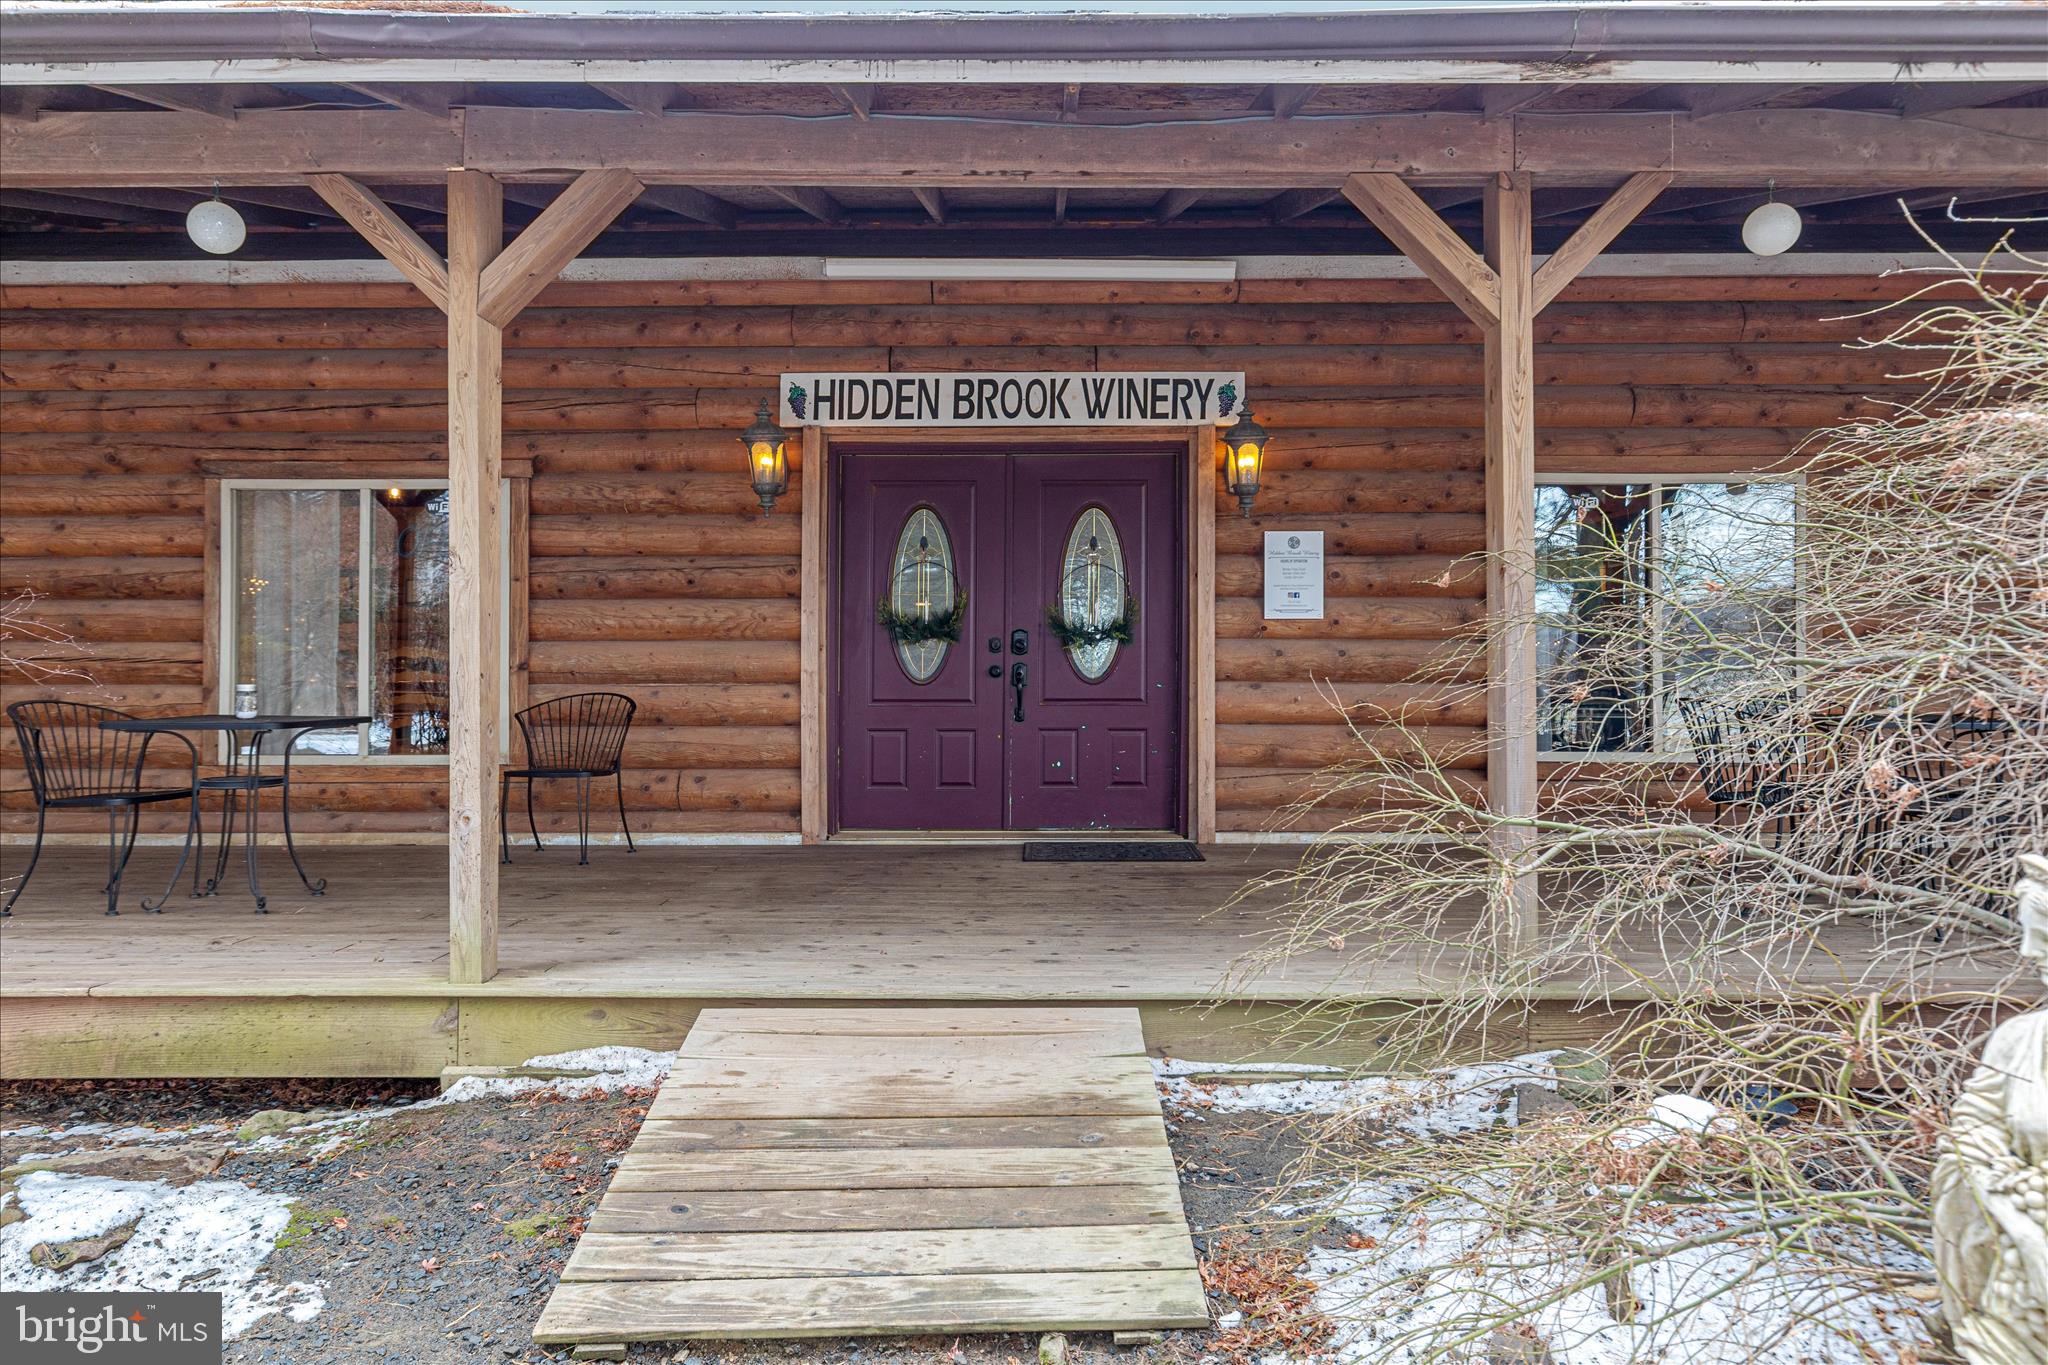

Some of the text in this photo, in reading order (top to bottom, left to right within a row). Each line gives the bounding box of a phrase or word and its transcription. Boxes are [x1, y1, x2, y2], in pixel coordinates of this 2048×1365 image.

[812, 377, 1216, 421] HIDDEN BROOK WINERY
